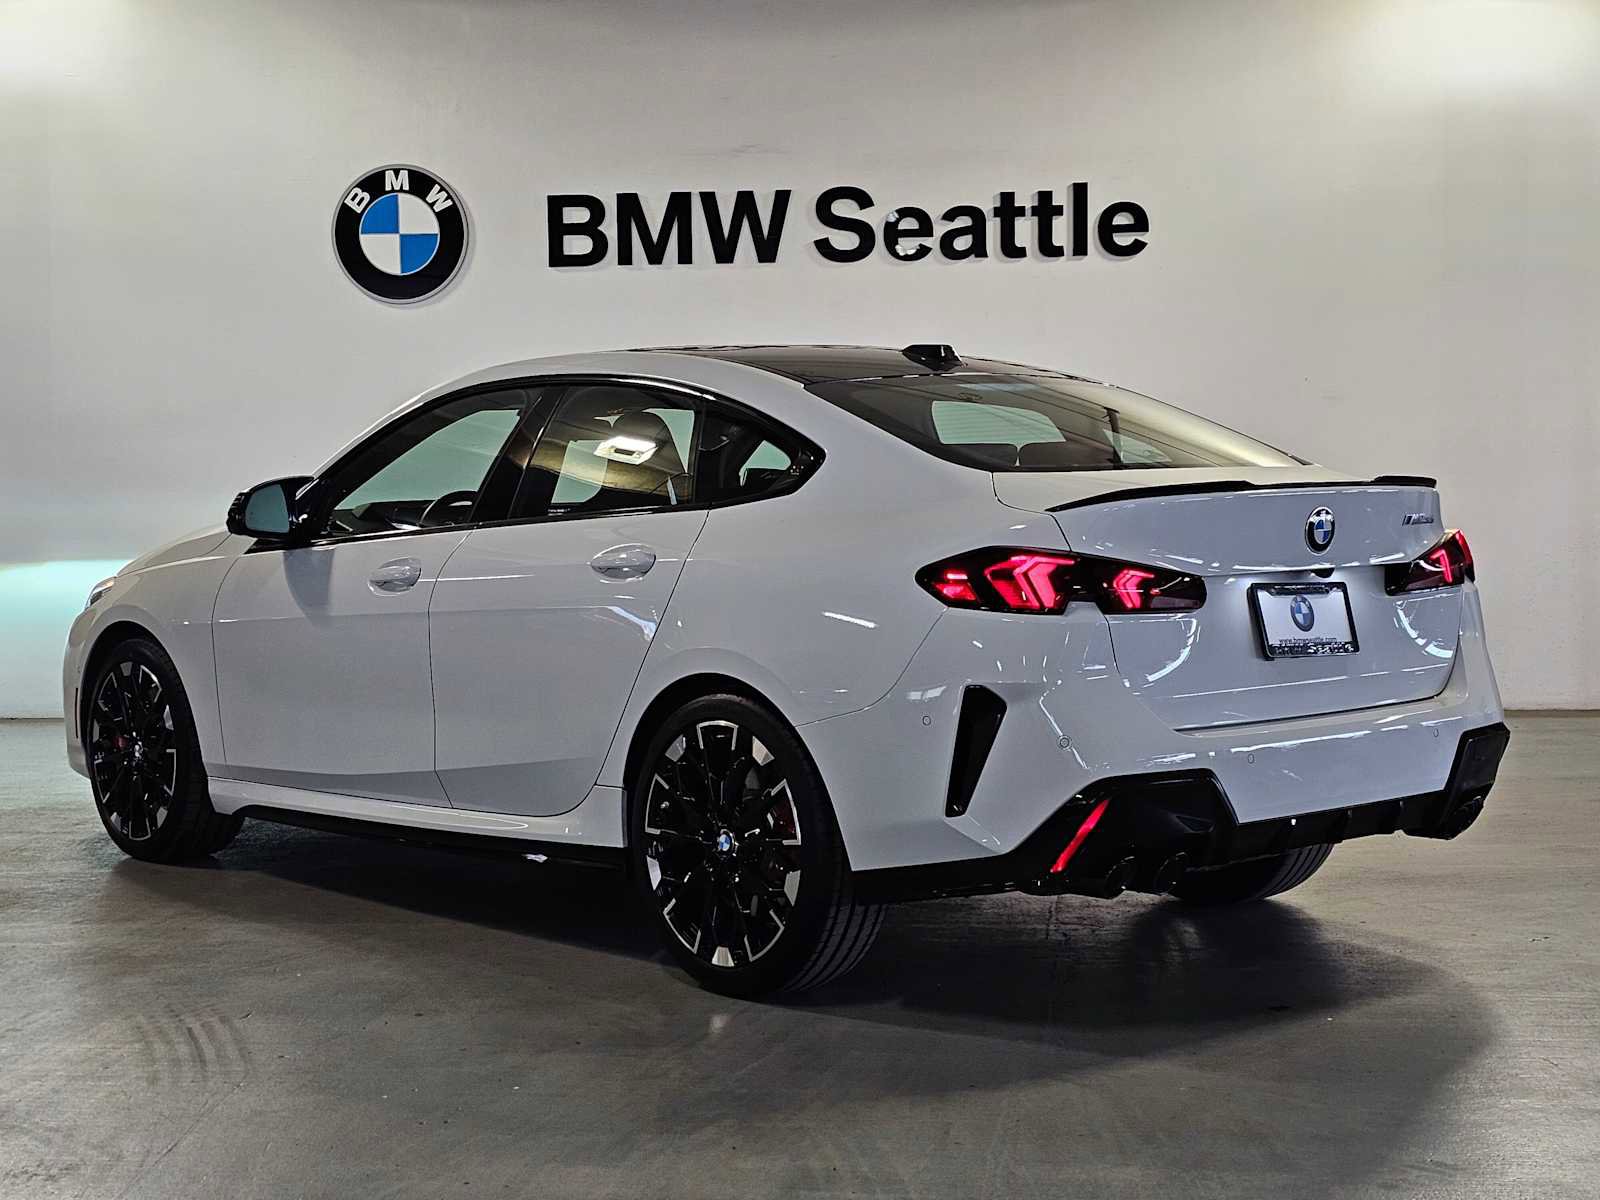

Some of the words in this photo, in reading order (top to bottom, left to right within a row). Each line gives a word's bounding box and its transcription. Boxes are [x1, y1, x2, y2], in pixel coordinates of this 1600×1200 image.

[344, 169, 454, 214] BMW
[546, 189, 792, 268] BMW
[813, 182, 1150, 263] Seattle
